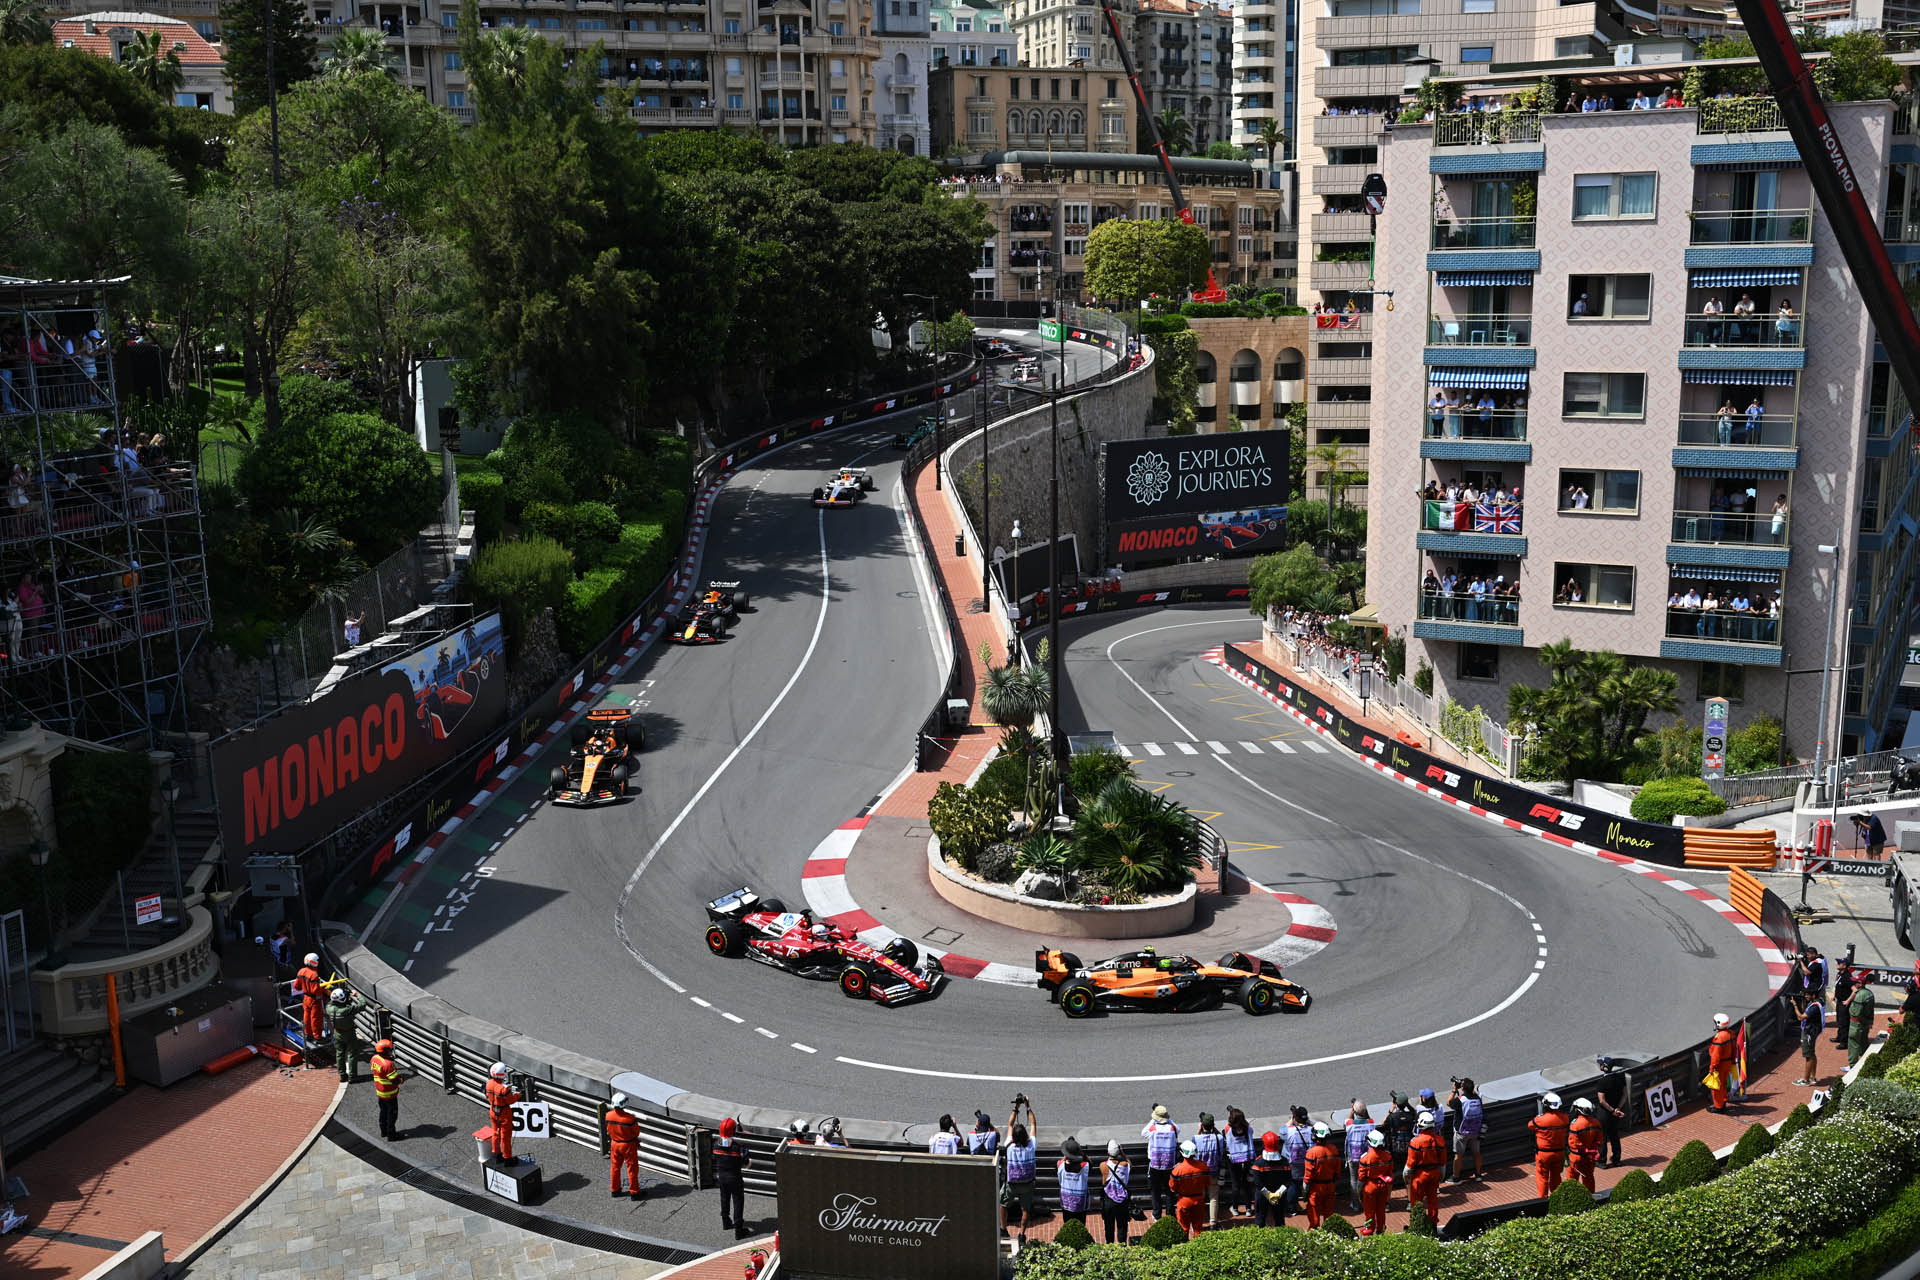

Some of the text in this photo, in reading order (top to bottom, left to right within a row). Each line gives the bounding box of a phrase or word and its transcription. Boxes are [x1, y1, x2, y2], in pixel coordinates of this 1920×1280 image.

[1818, 122, 1855, 193] PIOVANO
[1178, 445, 1265, 471] EXPLORA
[1176, 467, 1272, 500] JOURNEYS
[1118, 525, 1199, 552] MONACO
[243, 692, 406, 846] MONACO
[1605, 821, 1655, 850] Monaco
[1833, 863, 1886, 875] PIOVANO
[434, 866, 498, 932] TAXIS
[1650, 1087, 1674, 1118] SC
[511, 1107, 544, 1133] SC
[818, 1193, 950, 1237] Fairmont
[849, 1233, 922, 1247] MONTE CARLO
